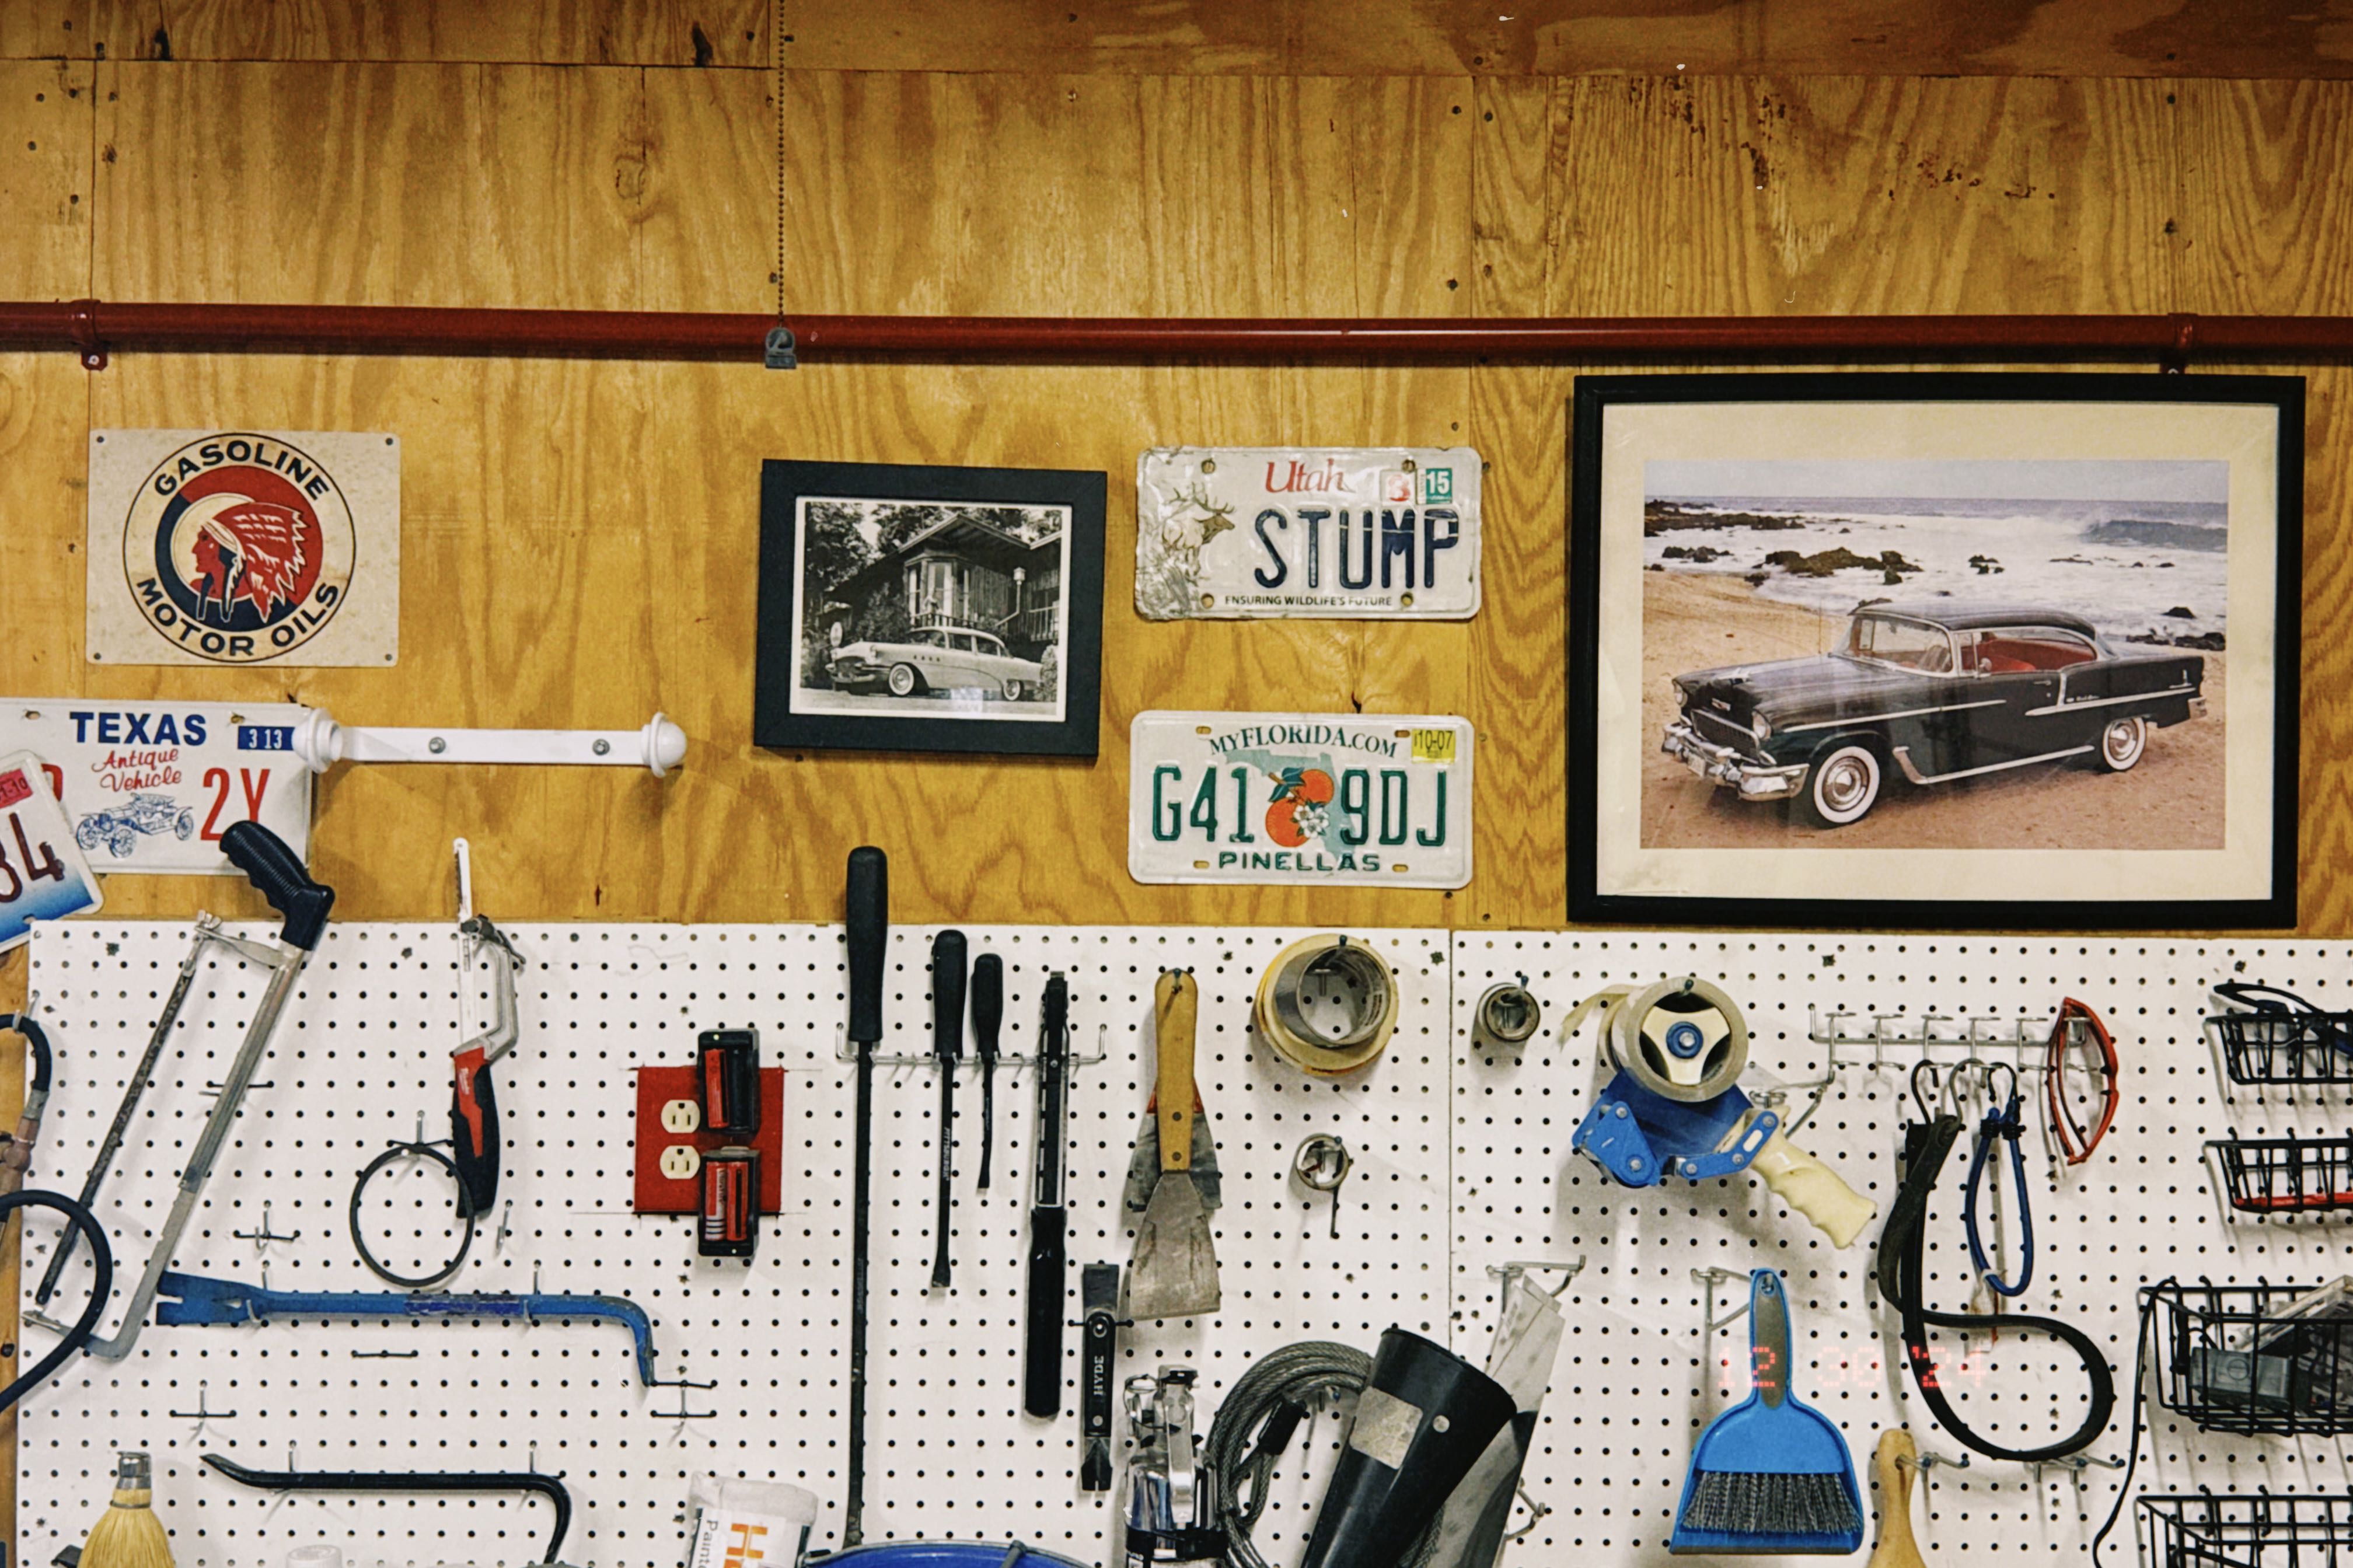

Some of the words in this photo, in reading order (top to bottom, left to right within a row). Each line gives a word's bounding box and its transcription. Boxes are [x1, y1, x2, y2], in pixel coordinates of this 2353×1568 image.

[154, 440, 330, 501] GASOLINE
[1265, 459, 1356, 494] Utah
[1426, 471, 1450, 494] 15
[1255, 509, 1459, 589] STUMP
[137, 577, 254, 656] MOTOR
[271, 582, 338, 648] OILS
[1225, 595, 1282, 606] ENSURING
[1284, 595, 1345, 606] WILDLIFE'S
[1349, 596, 1392, 606] FUTURE
[69, 711, 207, 746] TEXAS
[249, 728, 257, 749] 3
[264, 728, 282, 749] 13
[1210, 724, 1398, 758] MYFLORIDA.COM
[1418, 729, 1454, 750] 10-07
[92, 748, 179, 774] Antique
[100, 763, 182, 792] Vehicle
[200, 767, 271, 841] 2Y
[1152, 764, 1255, 844] G41
[1340, 769, 1447, 846] 9DJ
[1219, 851, 1380, 872] PINELLAS
[1094, 1355, 1104, 1396] HYDE
